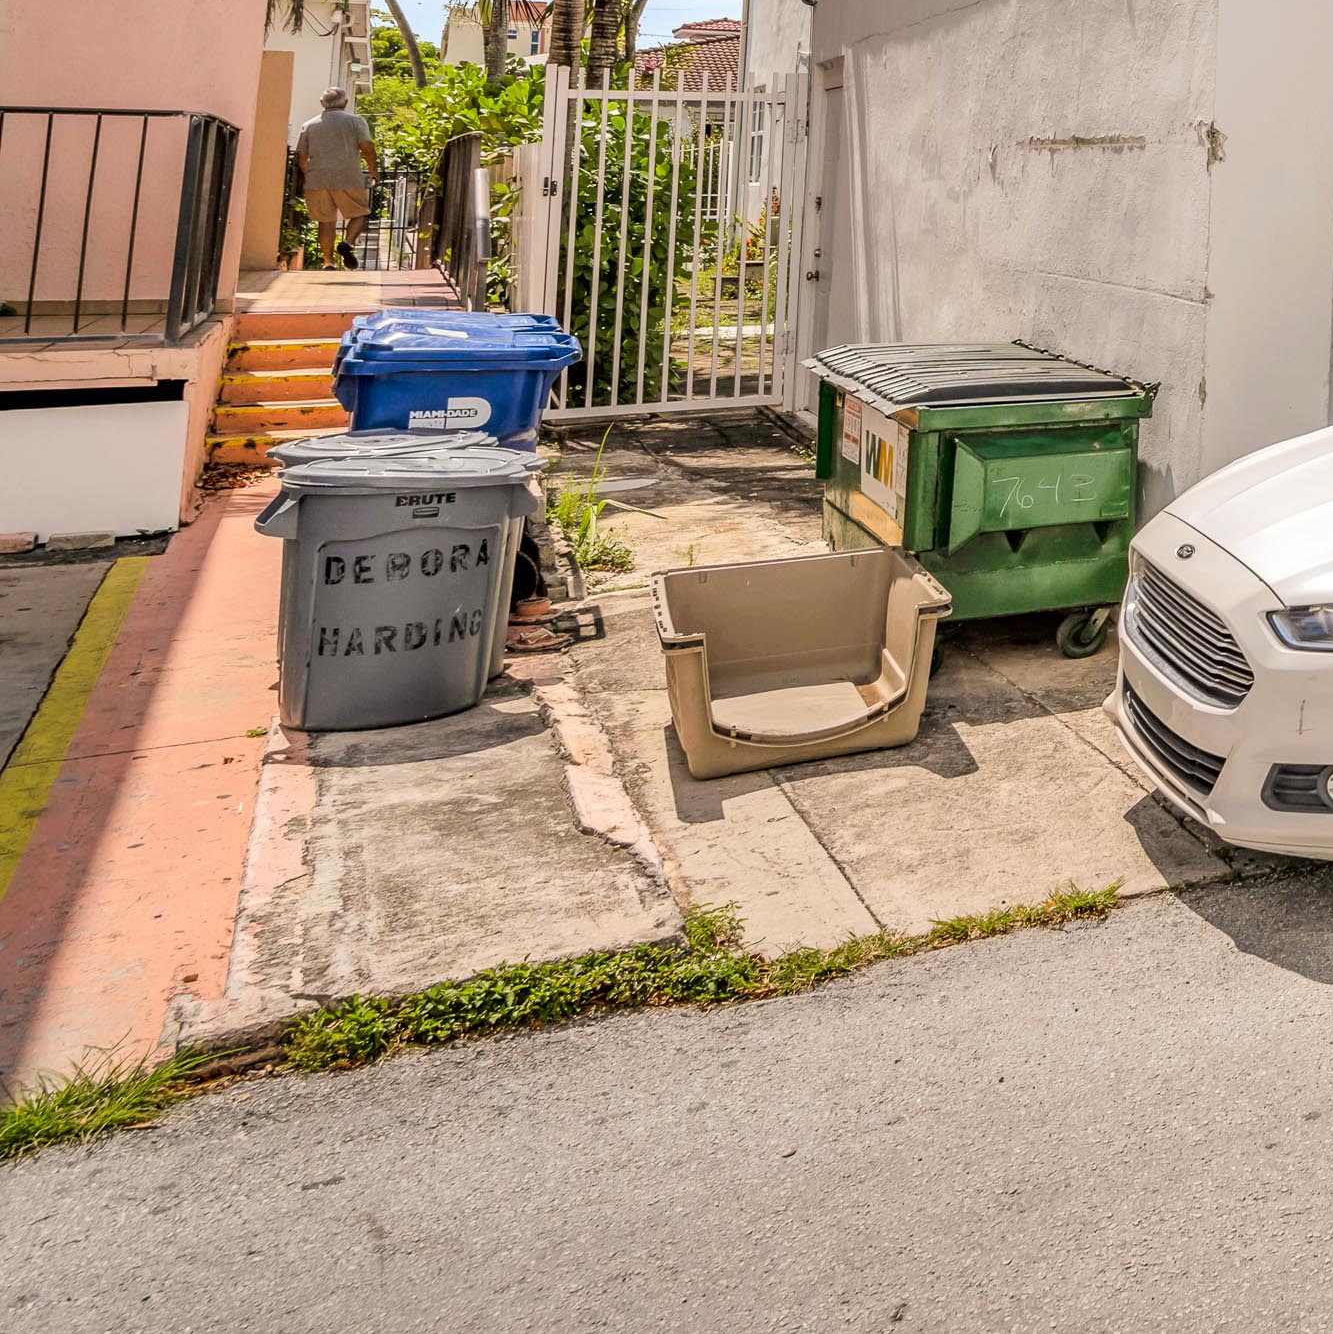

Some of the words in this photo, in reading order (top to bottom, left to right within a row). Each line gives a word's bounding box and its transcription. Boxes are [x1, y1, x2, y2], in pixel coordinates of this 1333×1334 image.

[409, 409, 477, 419] MIAMI-DADE
[865, 429, 894, 491] WM
[395, 492, 457, 507] BRUTE
[324, 538, 490, 585] DEBORA
[318, 609, 482, 657] HARDING
